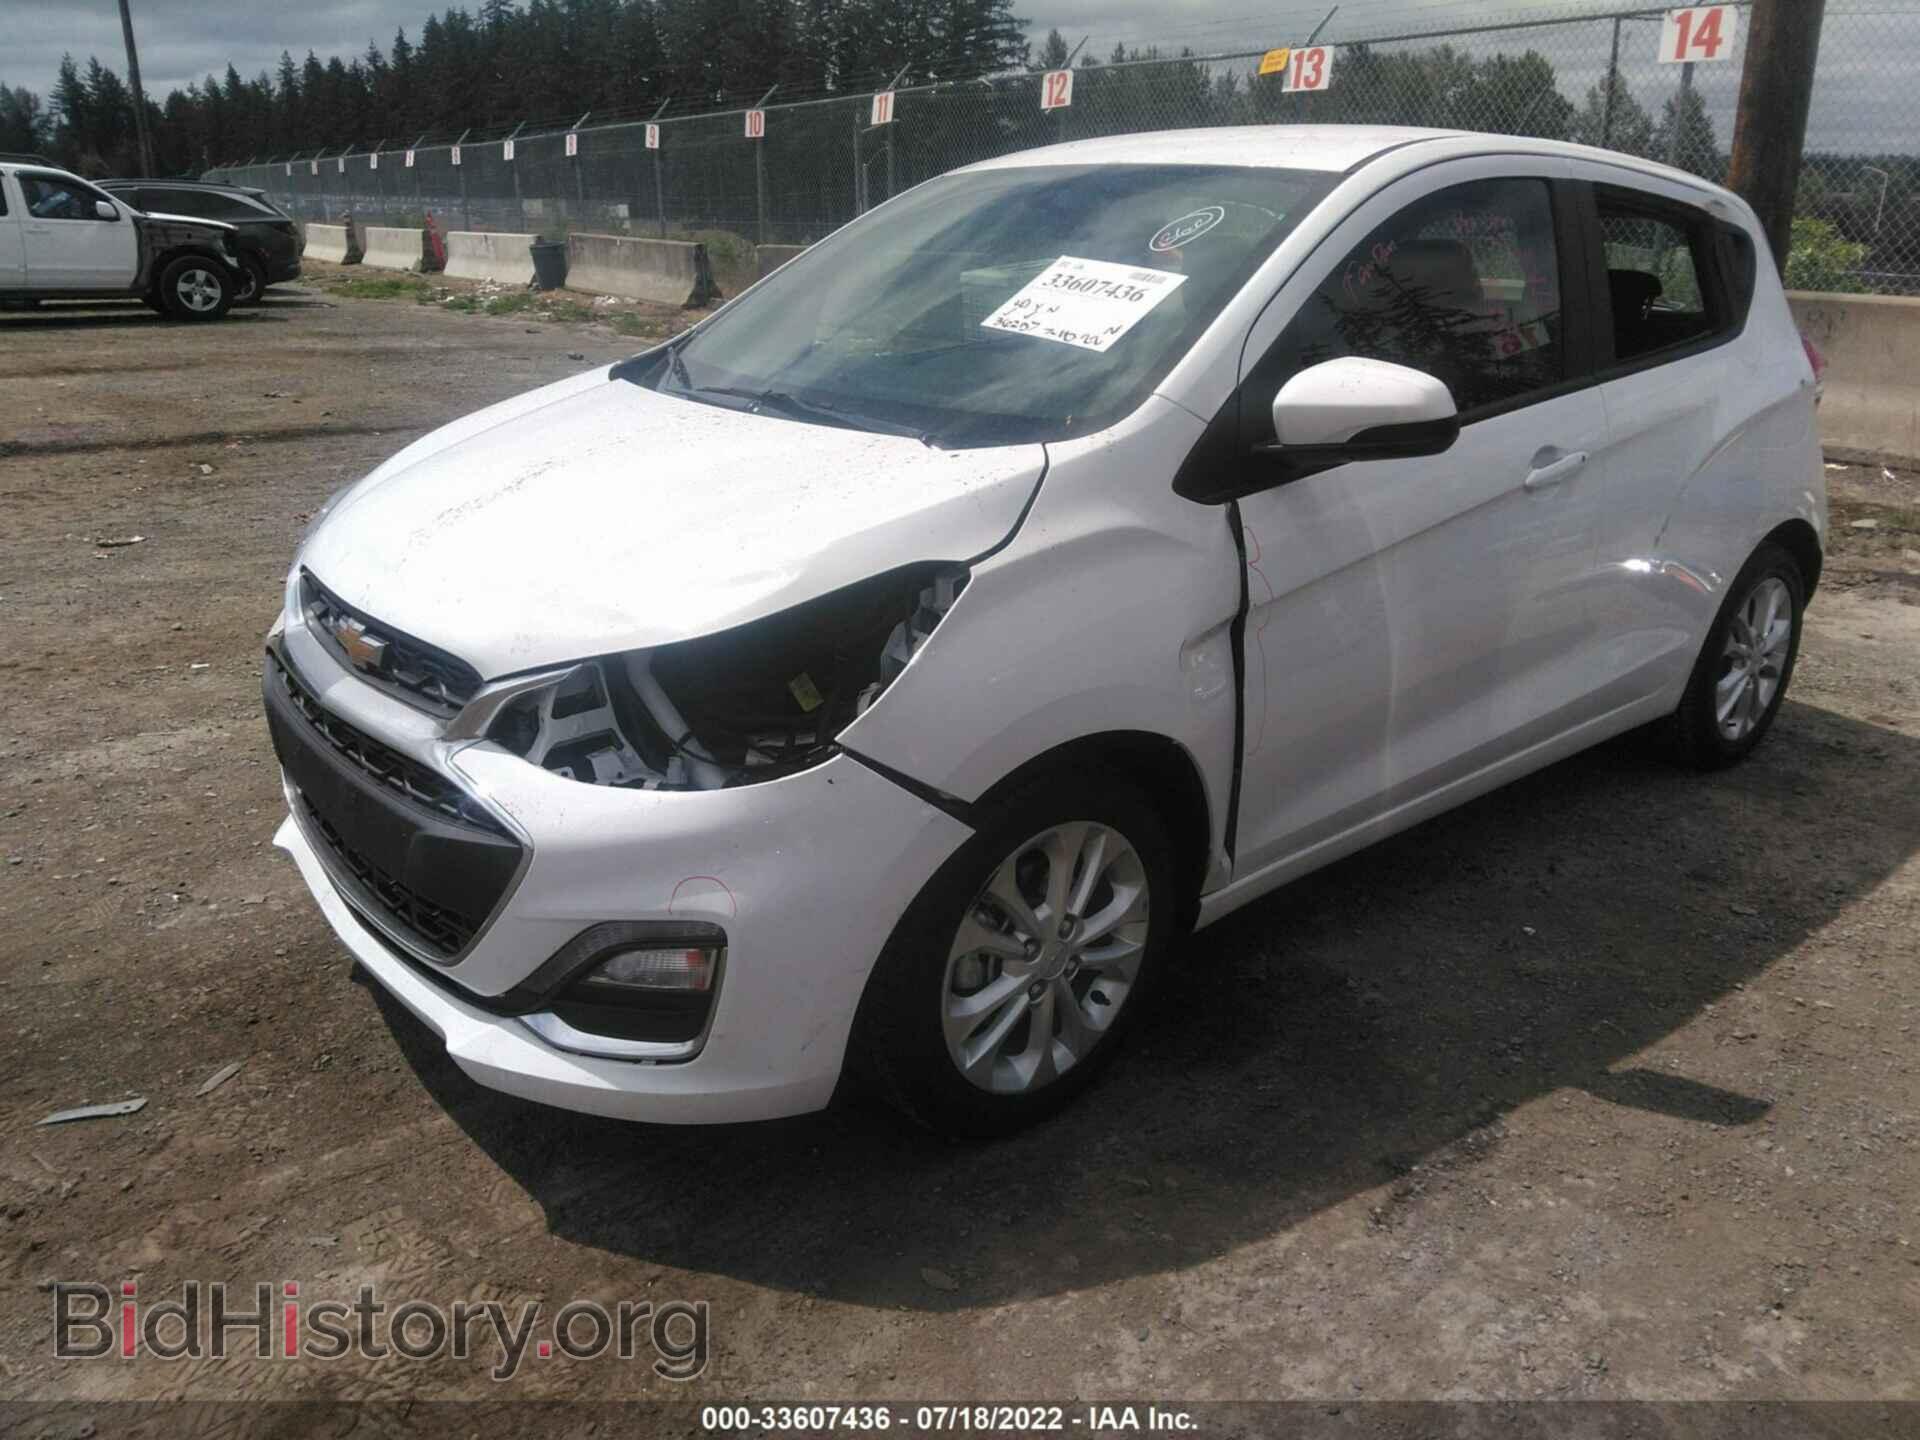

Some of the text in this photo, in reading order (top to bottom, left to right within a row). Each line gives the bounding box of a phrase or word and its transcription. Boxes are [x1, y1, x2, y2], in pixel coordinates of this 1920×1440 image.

[1674, 8, 1723, 59] 14
[1292, 48, 1325, 89] 13
[1047, 72, 1068, 107] 12
[748, 111, 761, 135] 10
[877, 95, 889, 122] 11
[649, 126, 656, 146] 9
[1042, 273, 1149, 302] 33607436
